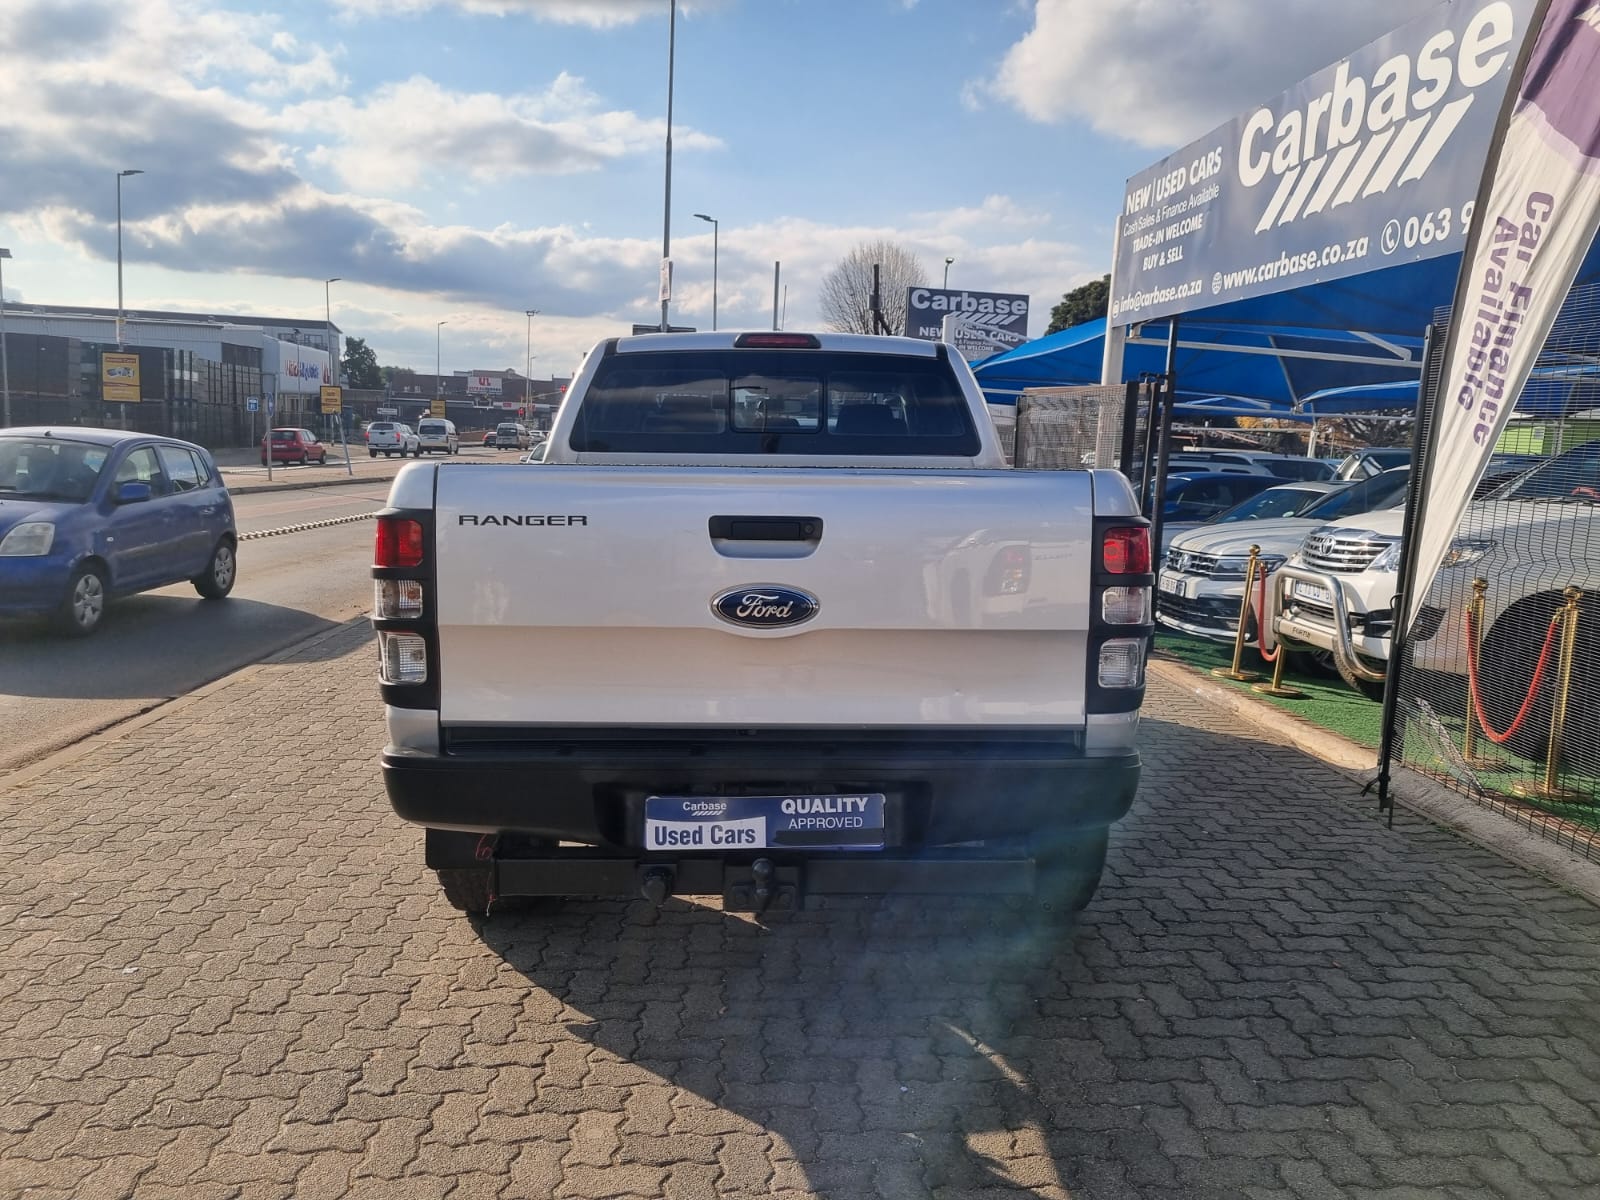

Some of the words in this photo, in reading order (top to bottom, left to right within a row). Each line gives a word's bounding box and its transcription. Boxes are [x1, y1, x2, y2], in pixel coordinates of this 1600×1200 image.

[1238, 1, 1513, 188] Carbase
[1126, 184, 1151, 216] NEW
[1156, 167, 1186, 201] USED
[1190, 146, 1222, 184] CARS
[1124, 220, 1138, 237] Cash
[1138, 214, 1155, 231] Sales
[1156, 209, 1161, 223] &
[1162, 202, 1187, 220] Finance
[1188, 183, 1220, 212] Available
[1404, 208, 1452, 248] 063
[1133, 229, 1164, 254] TRADE-IN
[1166, 213, 1204, 242] WELCOME
[1516, 191, 1555, 271] Car
[1143, 254, 1159, 271] BUY
[1159, 250, 1165, 266] &
[1167, 245, 1183, 264] SELL
[1223, 236, 1369, 290] www.carbase.co.za
[911, 289, 1027, 315] Carbase
[1120, 279, 1203, 312] info@carbase.co.za
[1457, 216, 1519, 411] Available
[1472, 281, 1533, 447] Finance
[459, 515, 588, 526] RANGER
[736, 594, 794, 618] Ford
[682, 801, 727, 811] Carbase
[781, 797, 868, 814] QUALITY
[788, 817, 863, 830] APPROVED
[654, 825, 703, 845] Used
[710, 824, 756, 845] Cars
